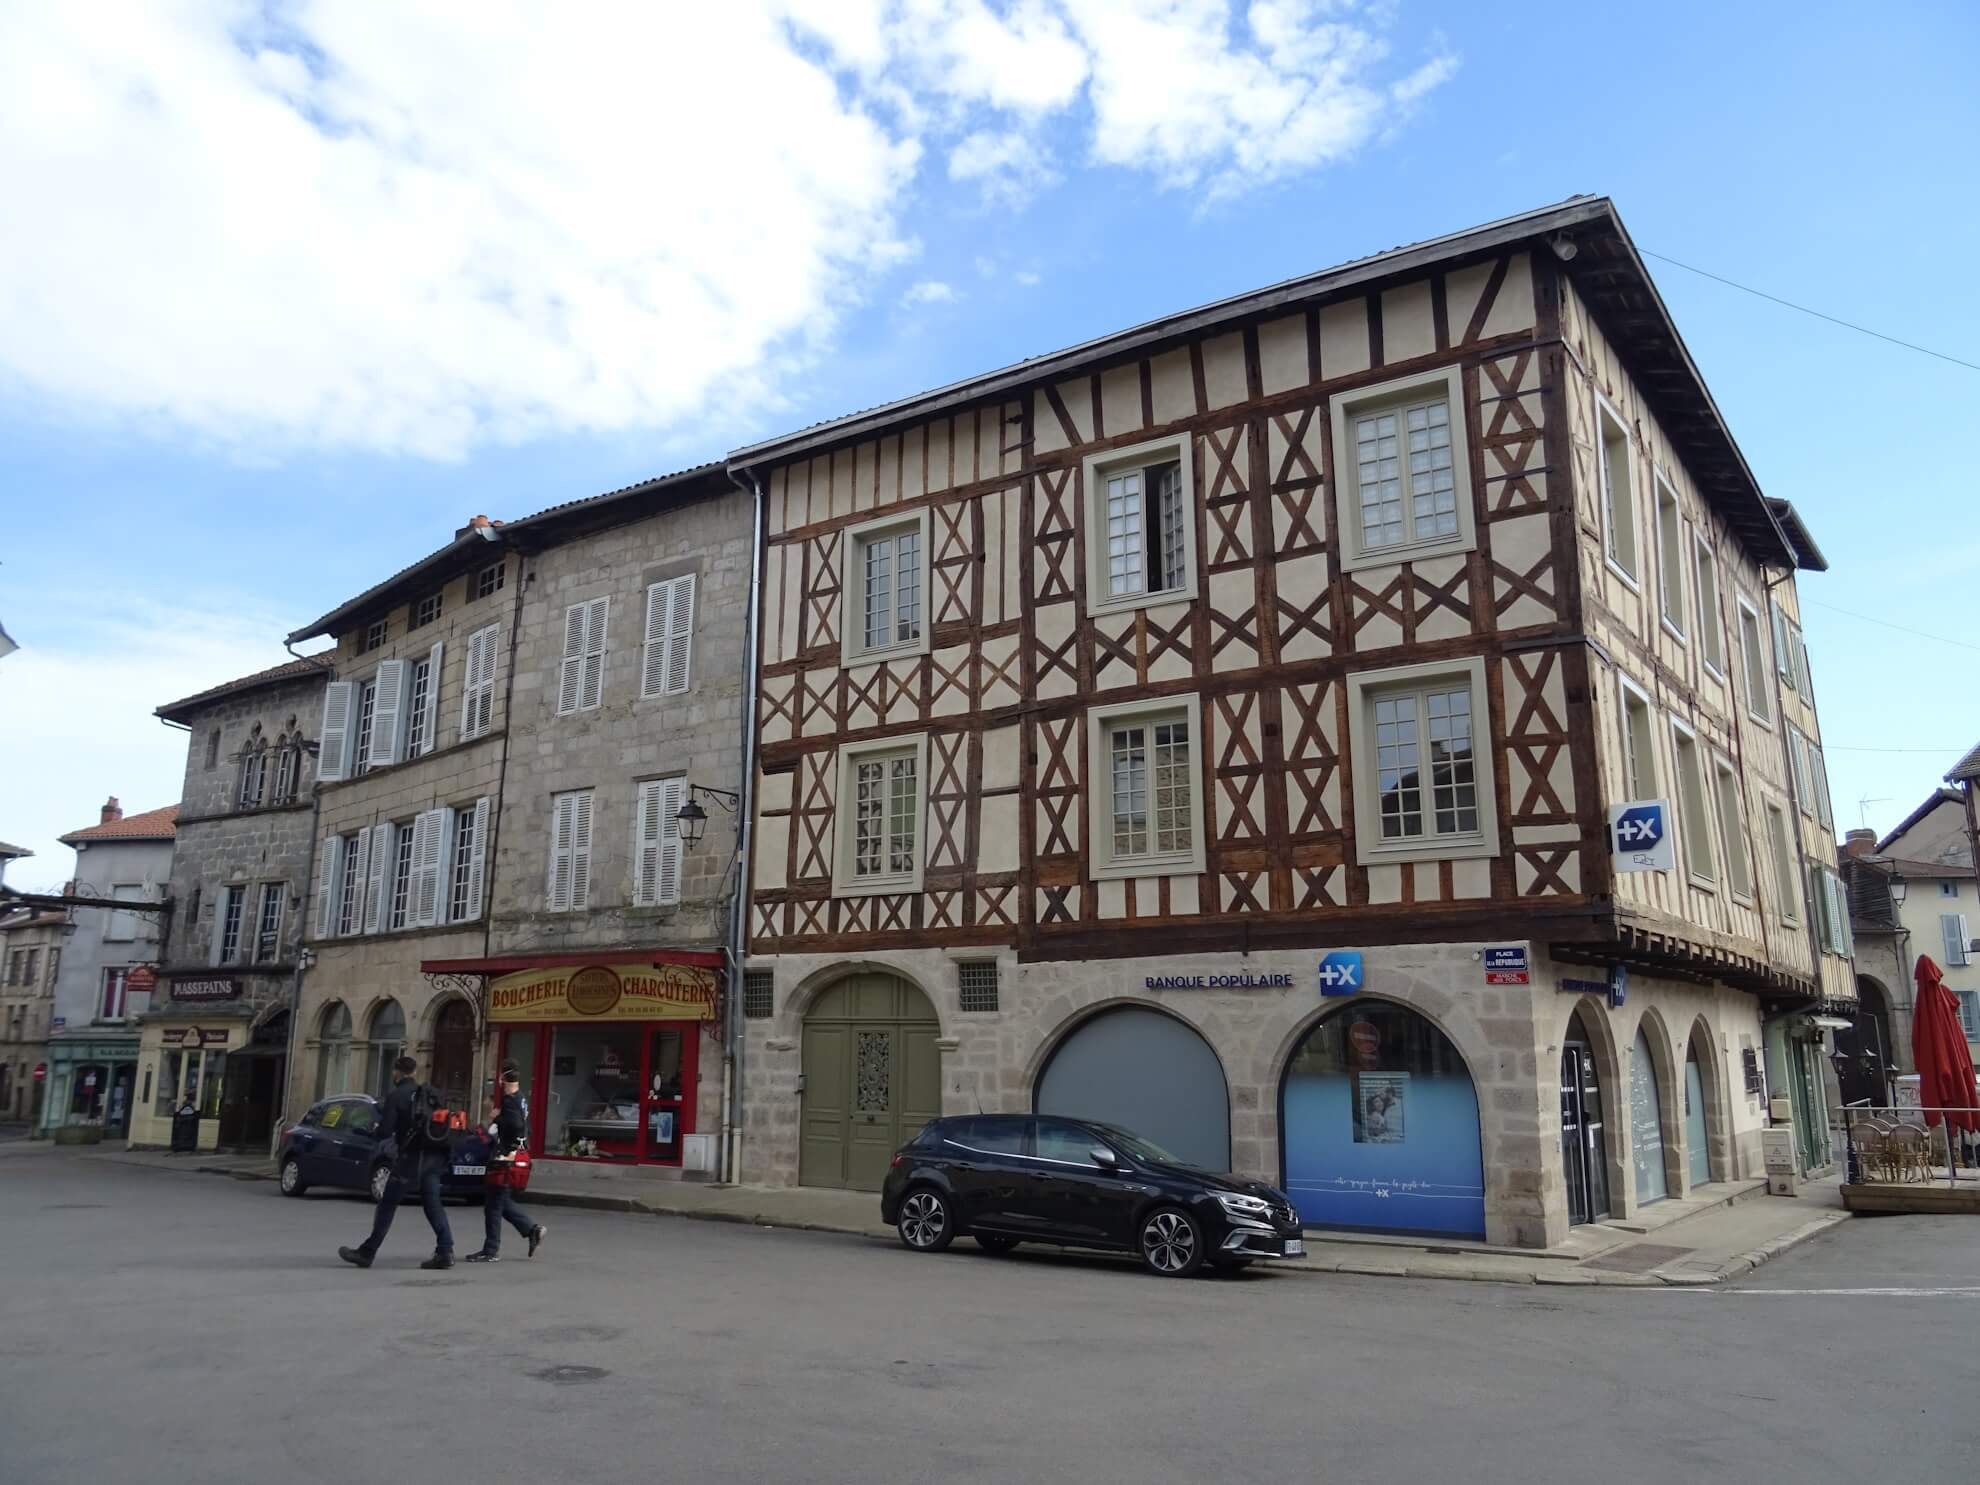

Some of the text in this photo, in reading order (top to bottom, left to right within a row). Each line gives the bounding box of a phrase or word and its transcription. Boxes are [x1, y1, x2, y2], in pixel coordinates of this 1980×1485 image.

[1145, 974, 1293, 988] BANQUE POPULAIRE
[492, 979, 566, 1008] BOUCHERIE
